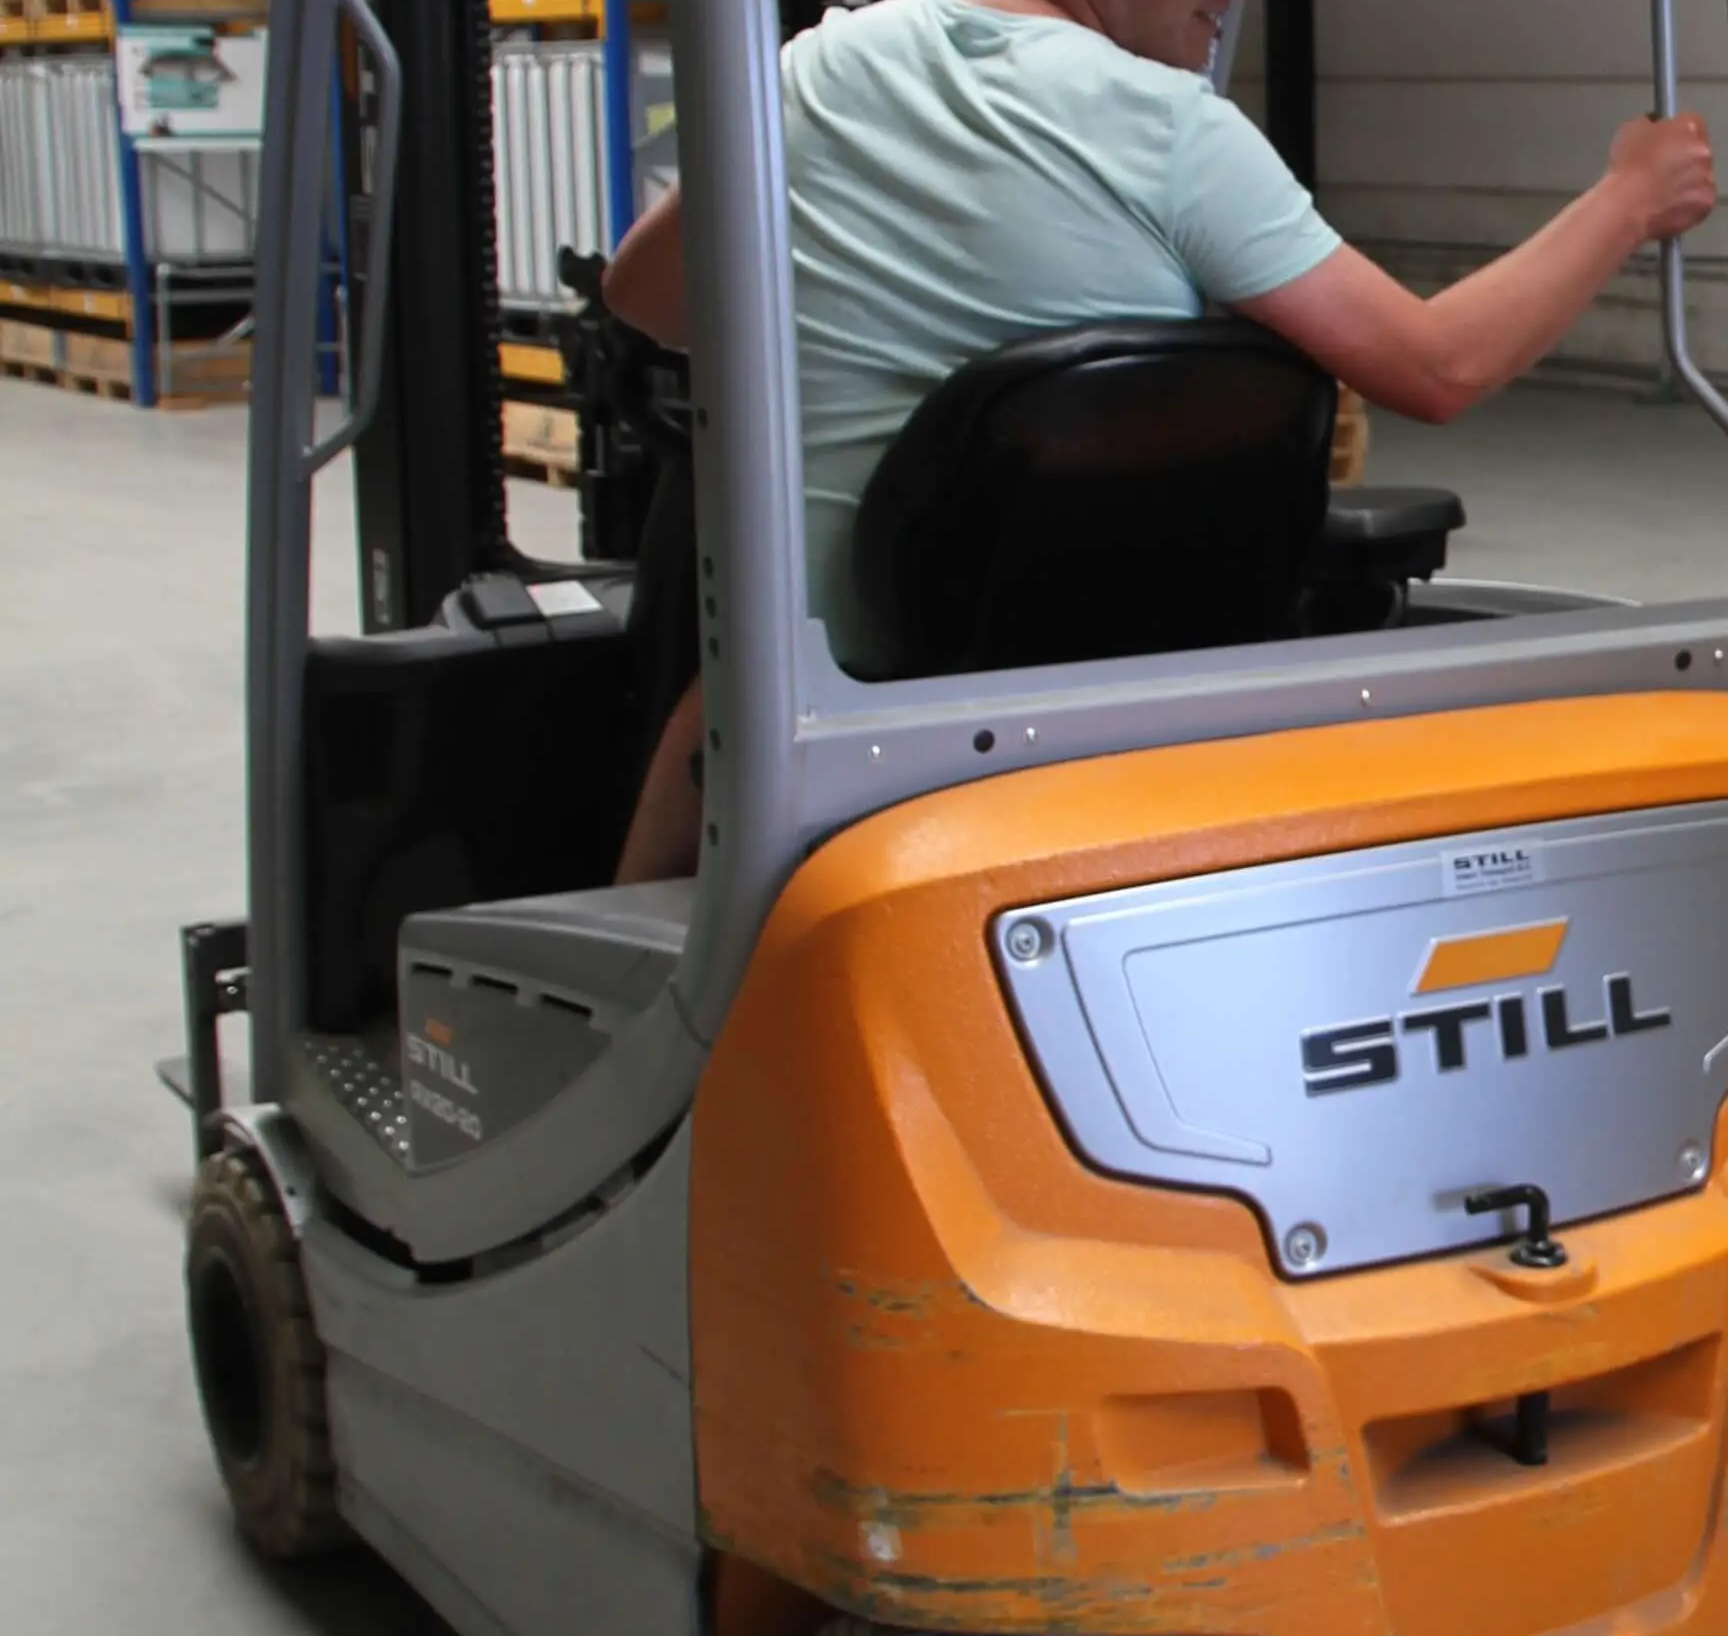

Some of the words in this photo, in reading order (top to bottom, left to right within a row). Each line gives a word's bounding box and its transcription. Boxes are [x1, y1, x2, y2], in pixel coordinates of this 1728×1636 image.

[1453, 850, 1529, 869] STILL
[406, 1033, 478, 1096] STILL
[1301, 972, 1672, 1099] STILL
